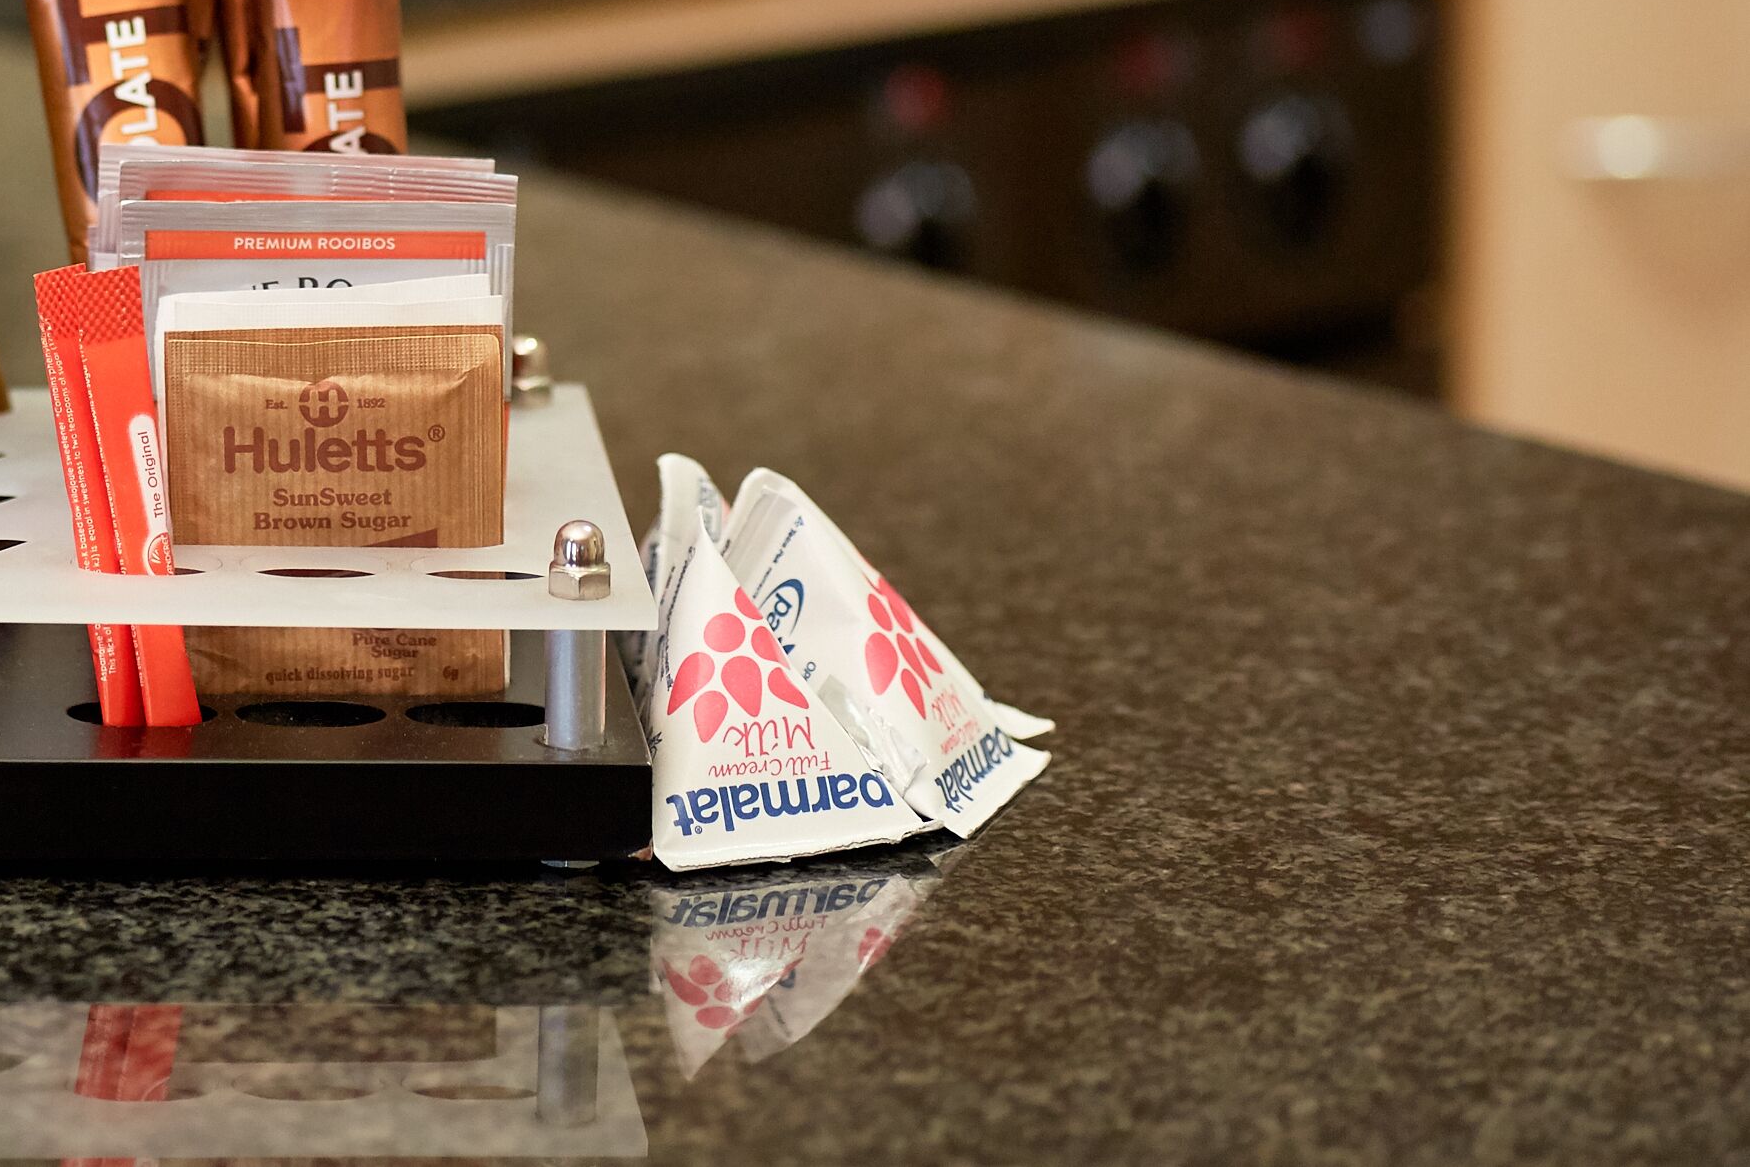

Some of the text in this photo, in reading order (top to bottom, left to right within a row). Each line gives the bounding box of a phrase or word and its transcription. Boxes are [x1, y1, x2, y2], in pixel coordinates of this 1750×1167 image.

[233, 237, 396, 250] PREMIUM ROOIBOS
[52, 351, 64, 375] sugar
[62, 386, 76, 431] teaspoons
[265, 398, 288, 410] Est.
[356, 397, 386, 409] 1892
[69, 432, 79, 449] two
[77, 460, 89, 505] sweetness
[142, 430, 165, 518] The Original
[272, 487, 392, 508] SunSweet
[73, 504, 82, 520] low
[253, 511, 412, 532] Brown Sugar
[76, 521, 87, 549] based
[85, 516, 96, 541] equal
[106, 636, 115, 656] stick
[352, 634, 437, 647] Pure Cane
[371, 646, 419, 660] Sugar
[108, 657, 117, 674] This
[265, 666, 415, 685] quick dissolving sugar
[723, 716, 815, 759] Milk
[708, 750, 831, 778] Full Cream
